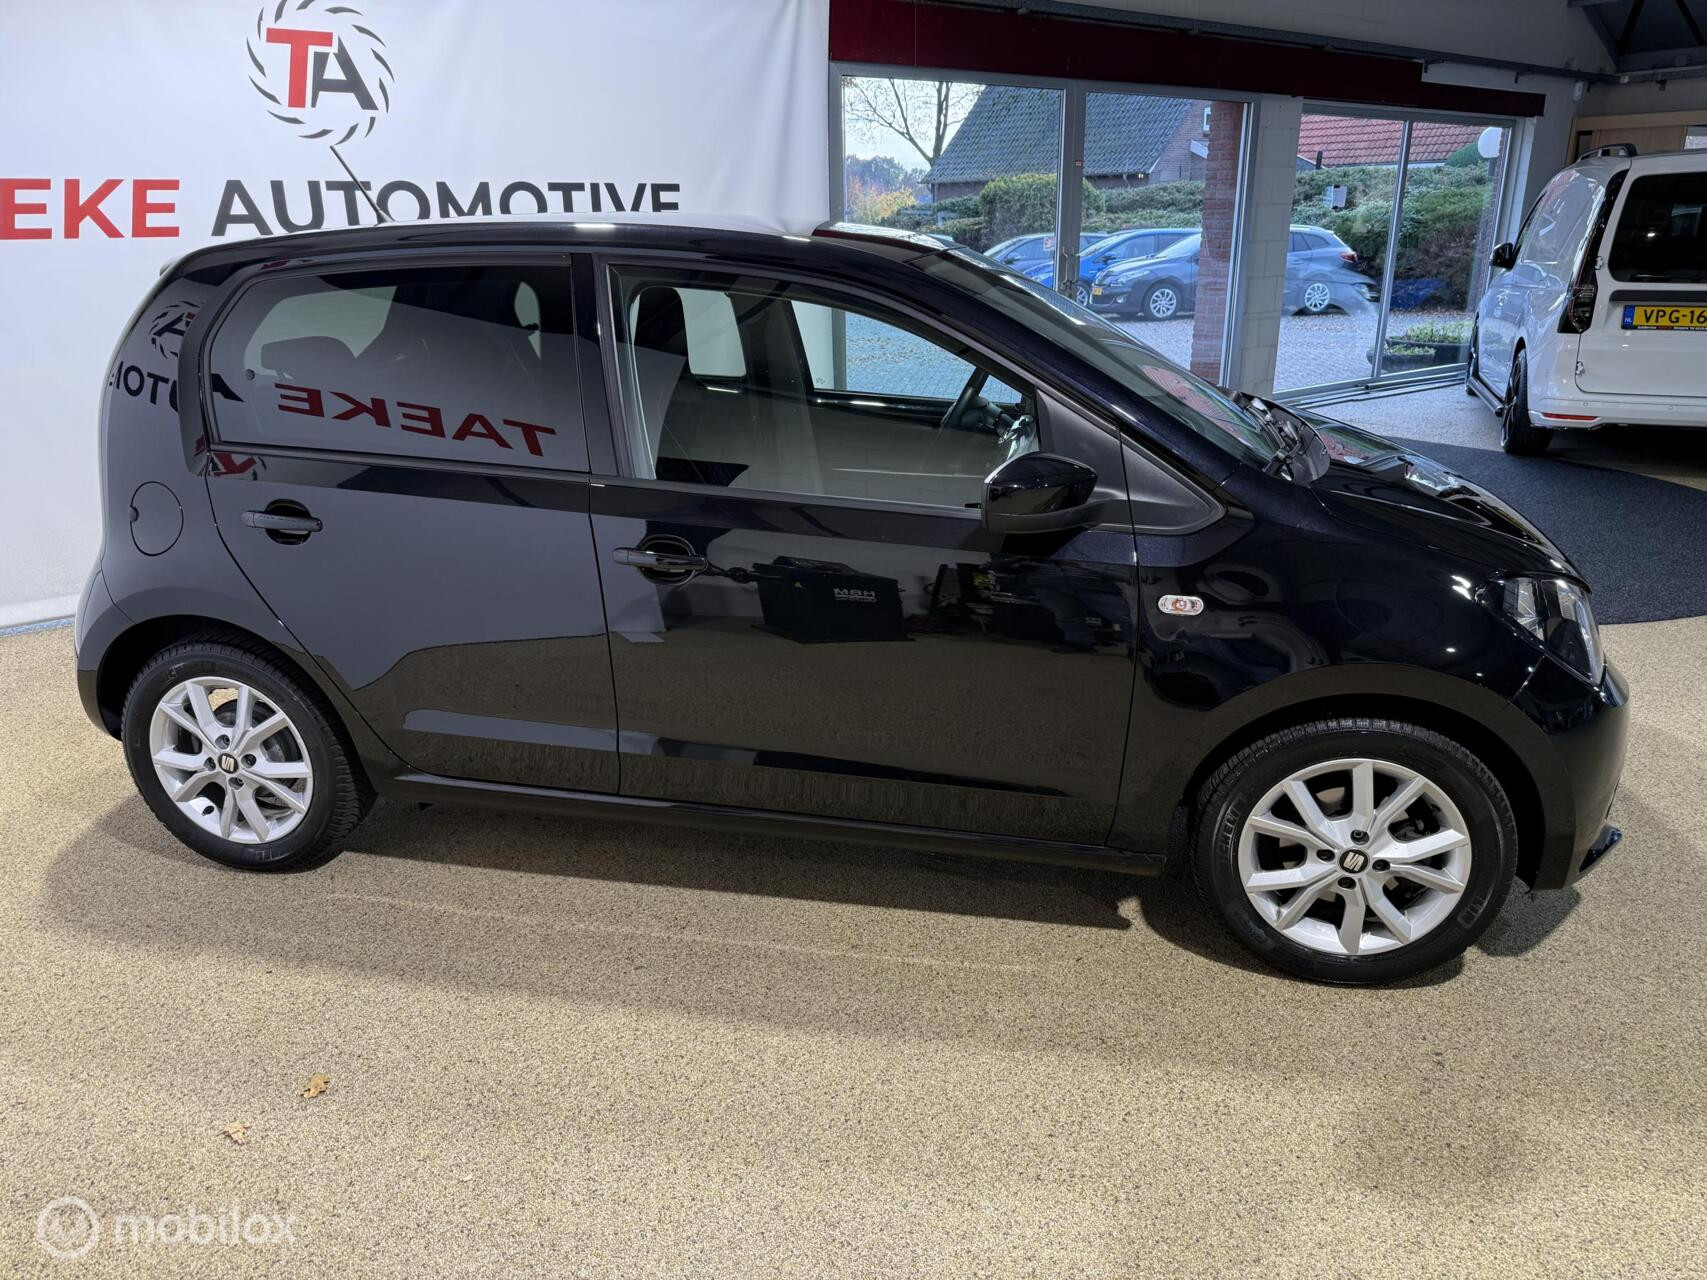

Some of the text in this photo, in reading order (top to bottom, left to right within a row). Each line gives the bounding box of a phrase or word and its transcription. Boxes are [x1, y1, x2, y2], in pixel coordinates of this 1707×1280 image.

[266, 28, 379, 111] TA
[211, 179, 681, 237] AUTOMOTIVE
[1643, 308, 1707, 324] VPG-16
[1216, 795, 1244, 874] ICHELIN
